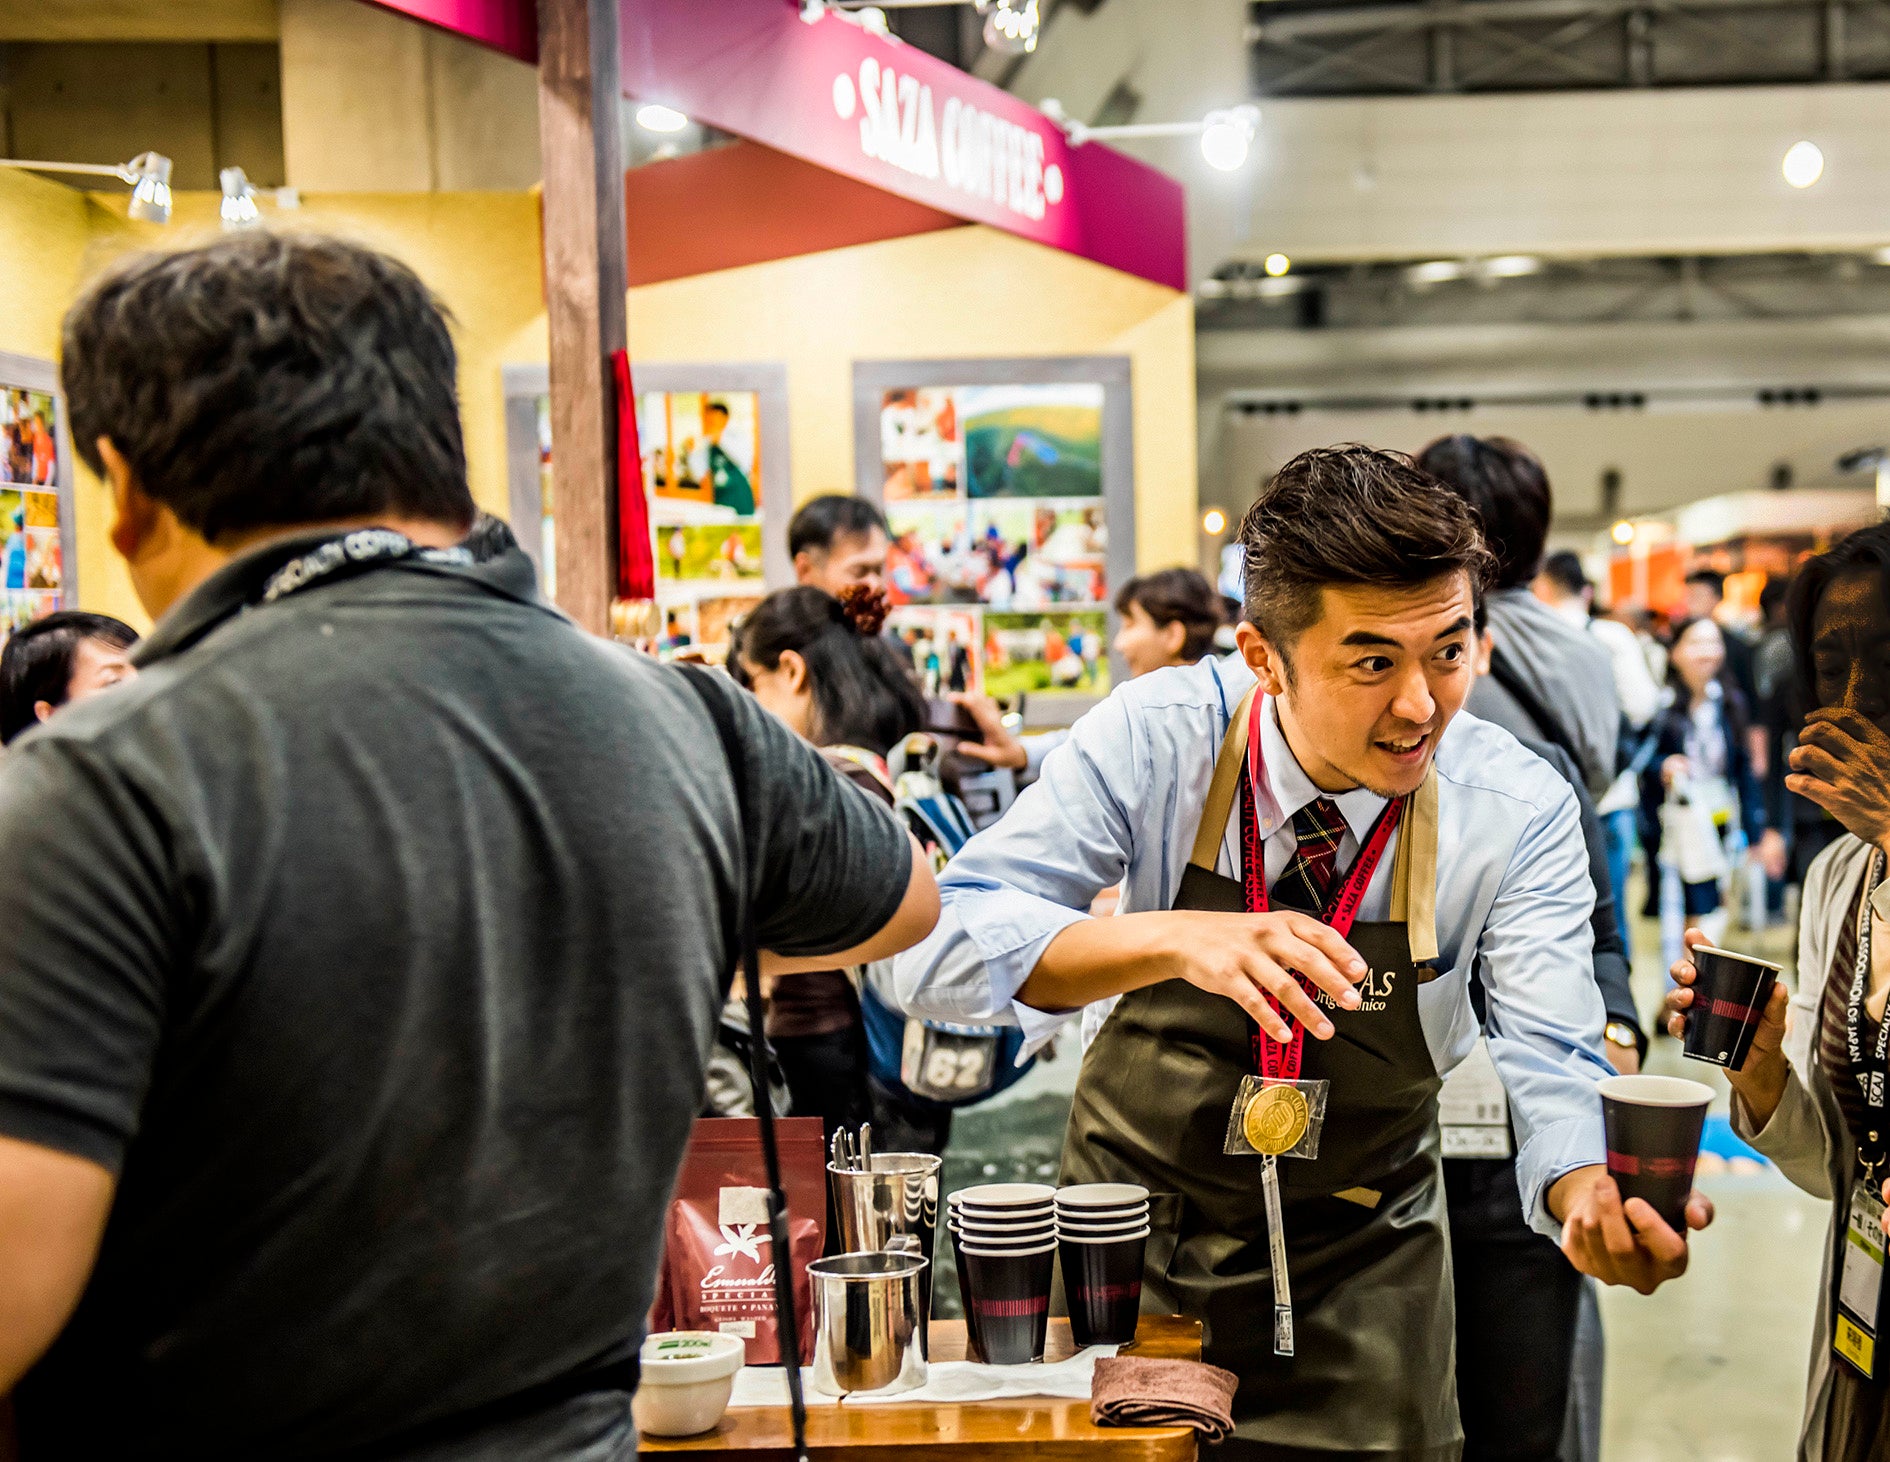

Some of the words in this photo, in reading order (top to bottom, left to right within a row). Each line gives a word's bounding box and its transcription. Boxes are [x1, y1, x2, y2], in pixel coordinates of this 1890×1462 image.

[859, 57, 940, 180] SAZA
[941, 97, 1046, 221] COFFEE
[1341, 891, 1359, 916] SAZA
[1353, 855, 1375, 891] COFFEE
[1847, 1026, 1862, 1063] JAPAN
[701, 1292, 768, 1300] SPECIA
